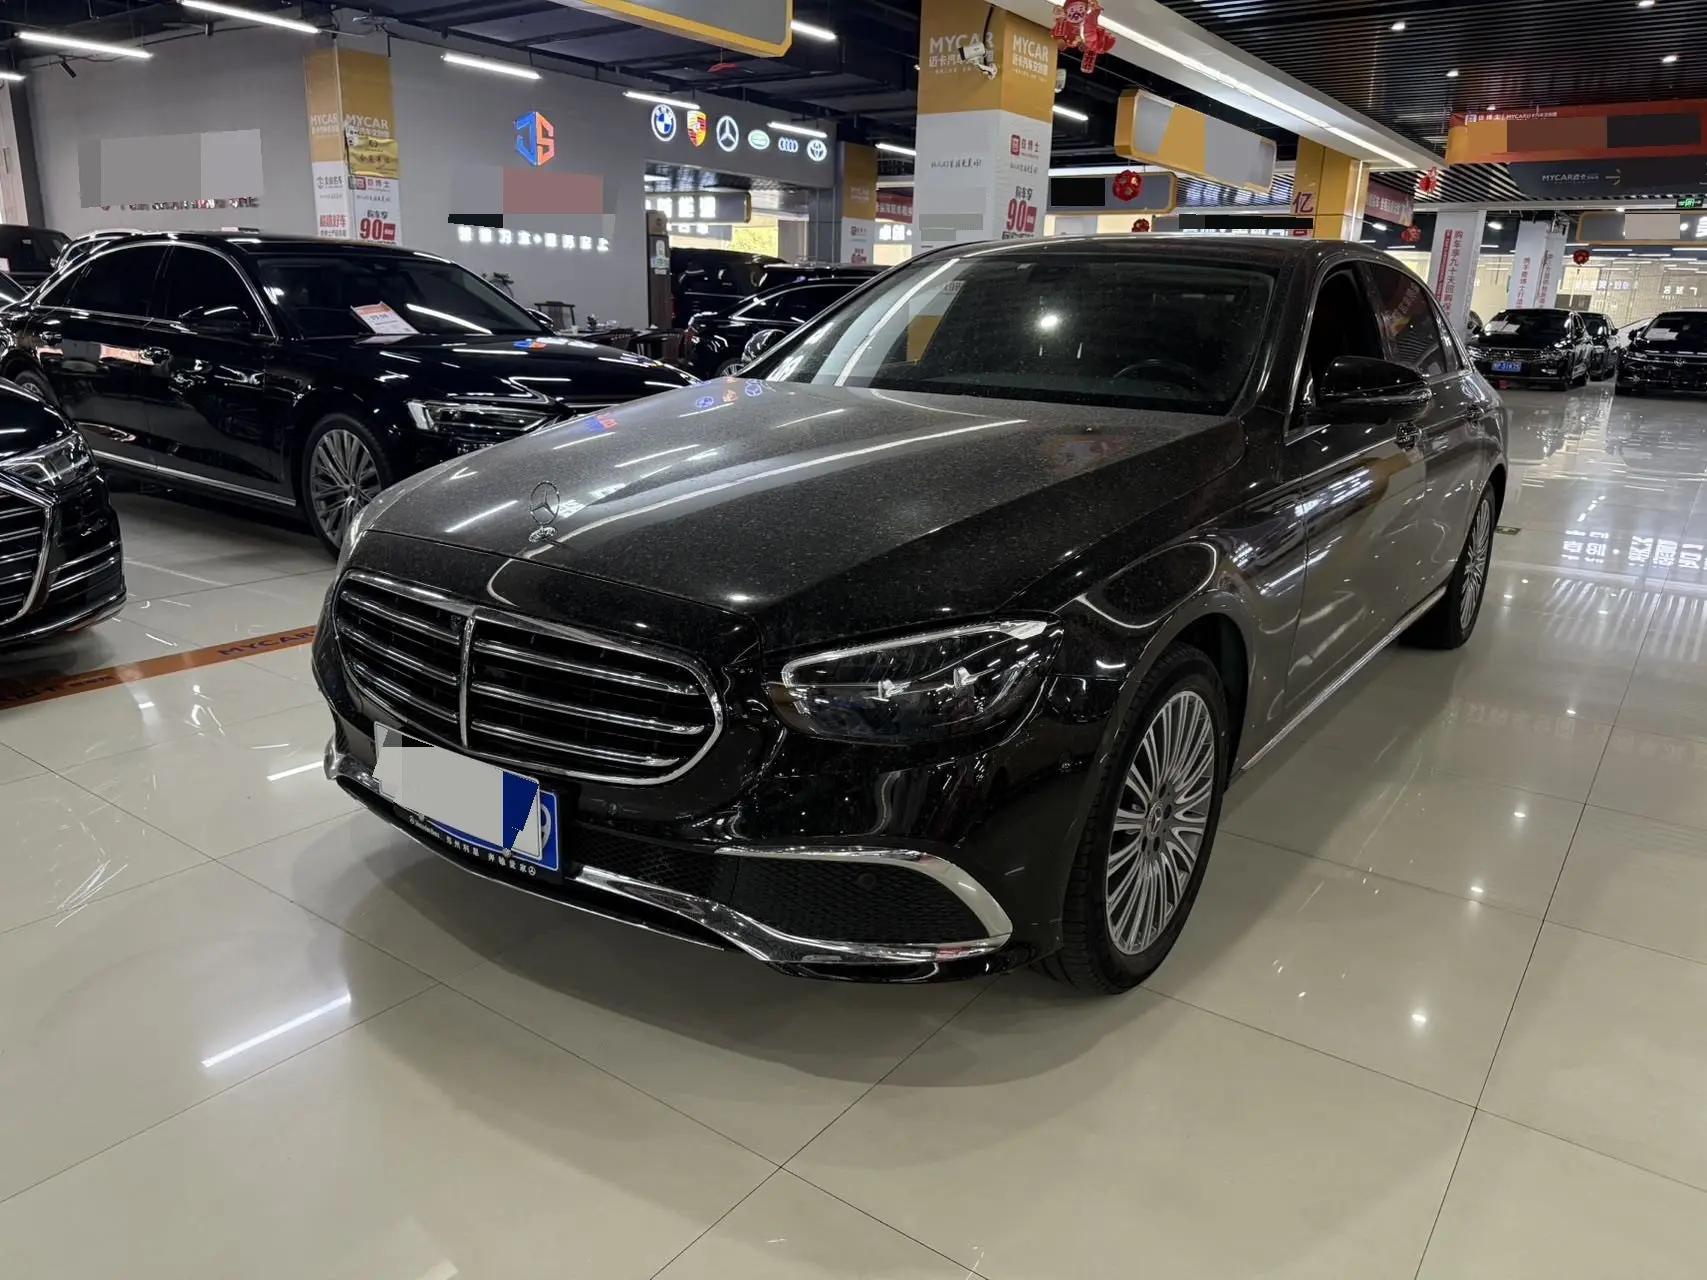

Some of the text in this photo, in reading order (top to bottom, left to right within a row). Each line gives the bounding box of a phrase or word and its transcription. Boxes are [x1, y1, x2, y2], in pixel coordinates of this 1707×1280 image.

[1012, 34, 1049, 62] MYCAR
[345, 113, 389, 129] MYCAR
[1292, 191, 1314, 213] 亿
[1006, 198, 1027, 232] 90
[360, 218, 383, 240] 90
